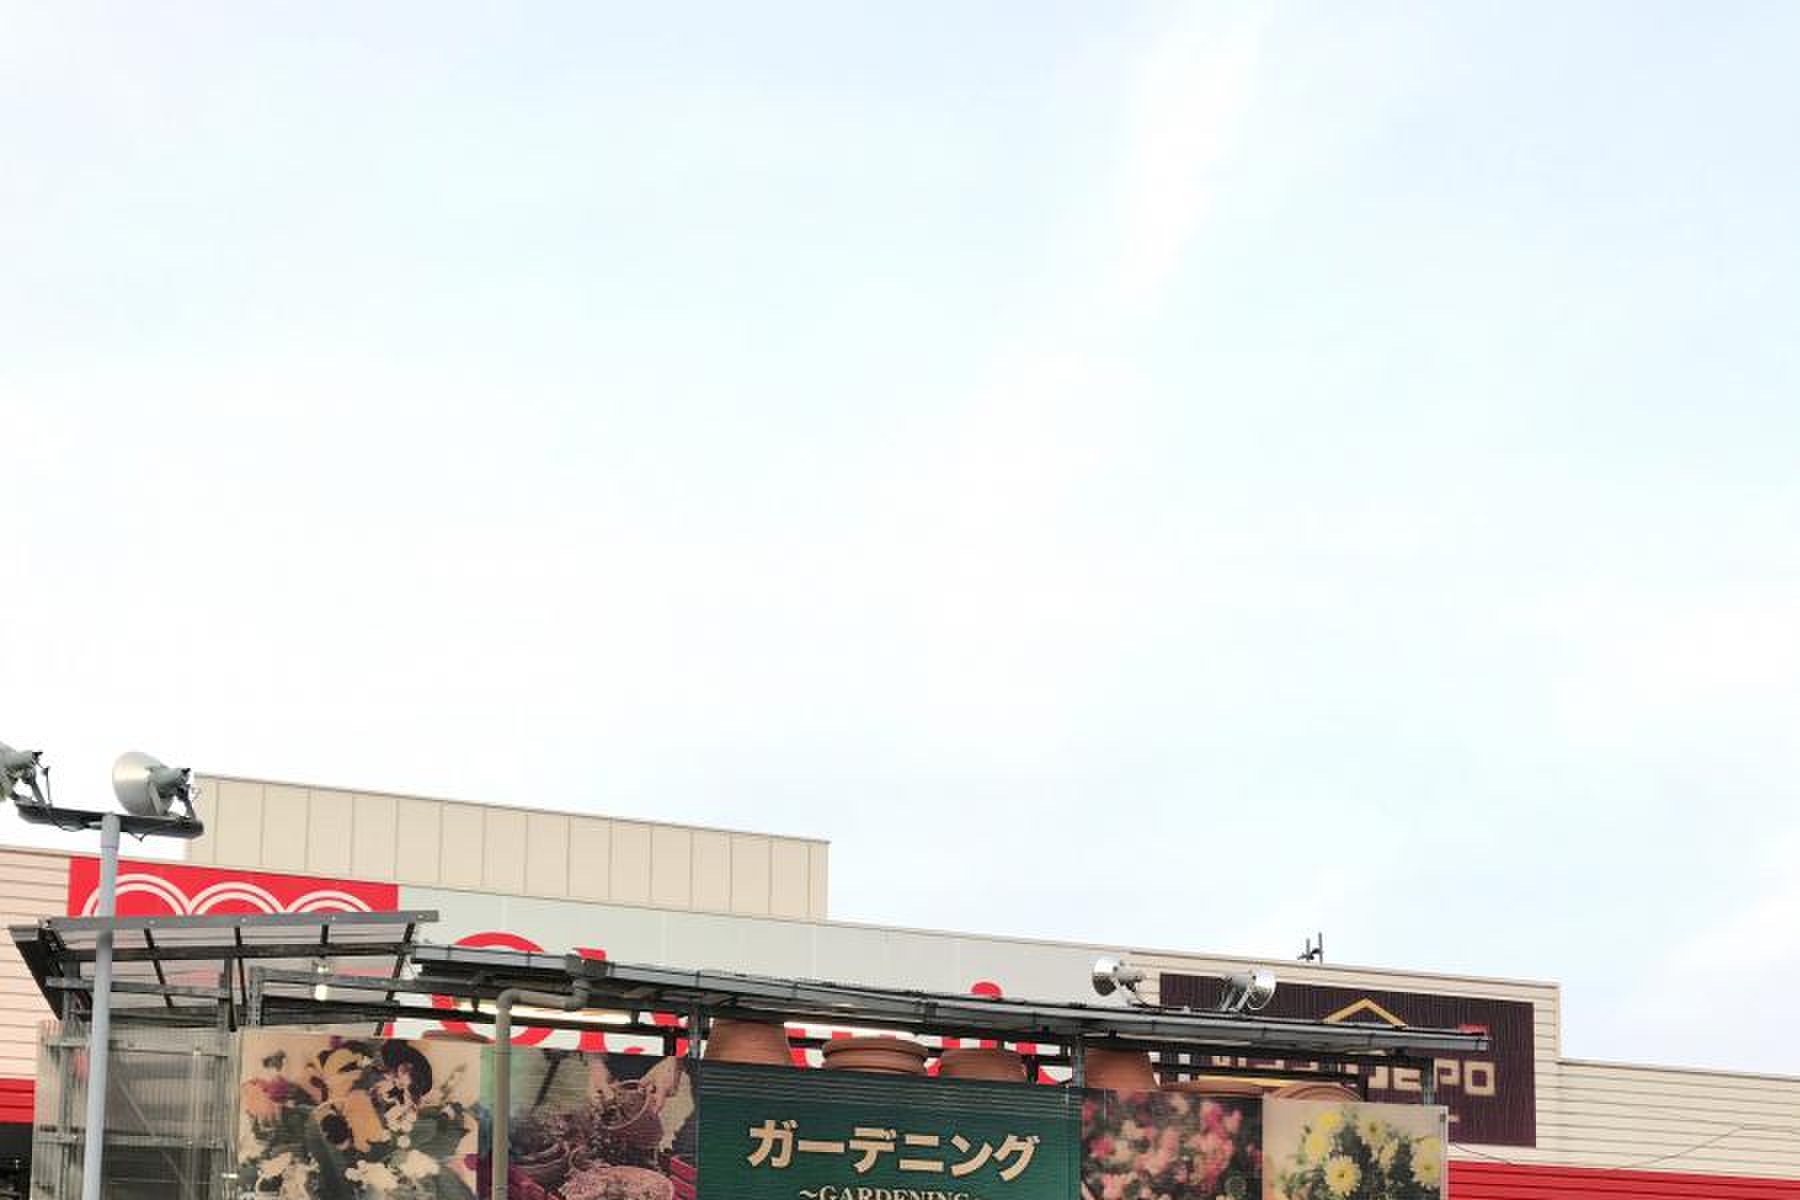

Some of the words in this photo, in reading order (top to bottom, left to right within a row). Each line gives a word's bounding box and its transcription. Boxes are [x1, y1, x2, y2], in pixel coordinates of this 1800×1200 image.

[747, 1119, 1041, 1181] ガーデニング
